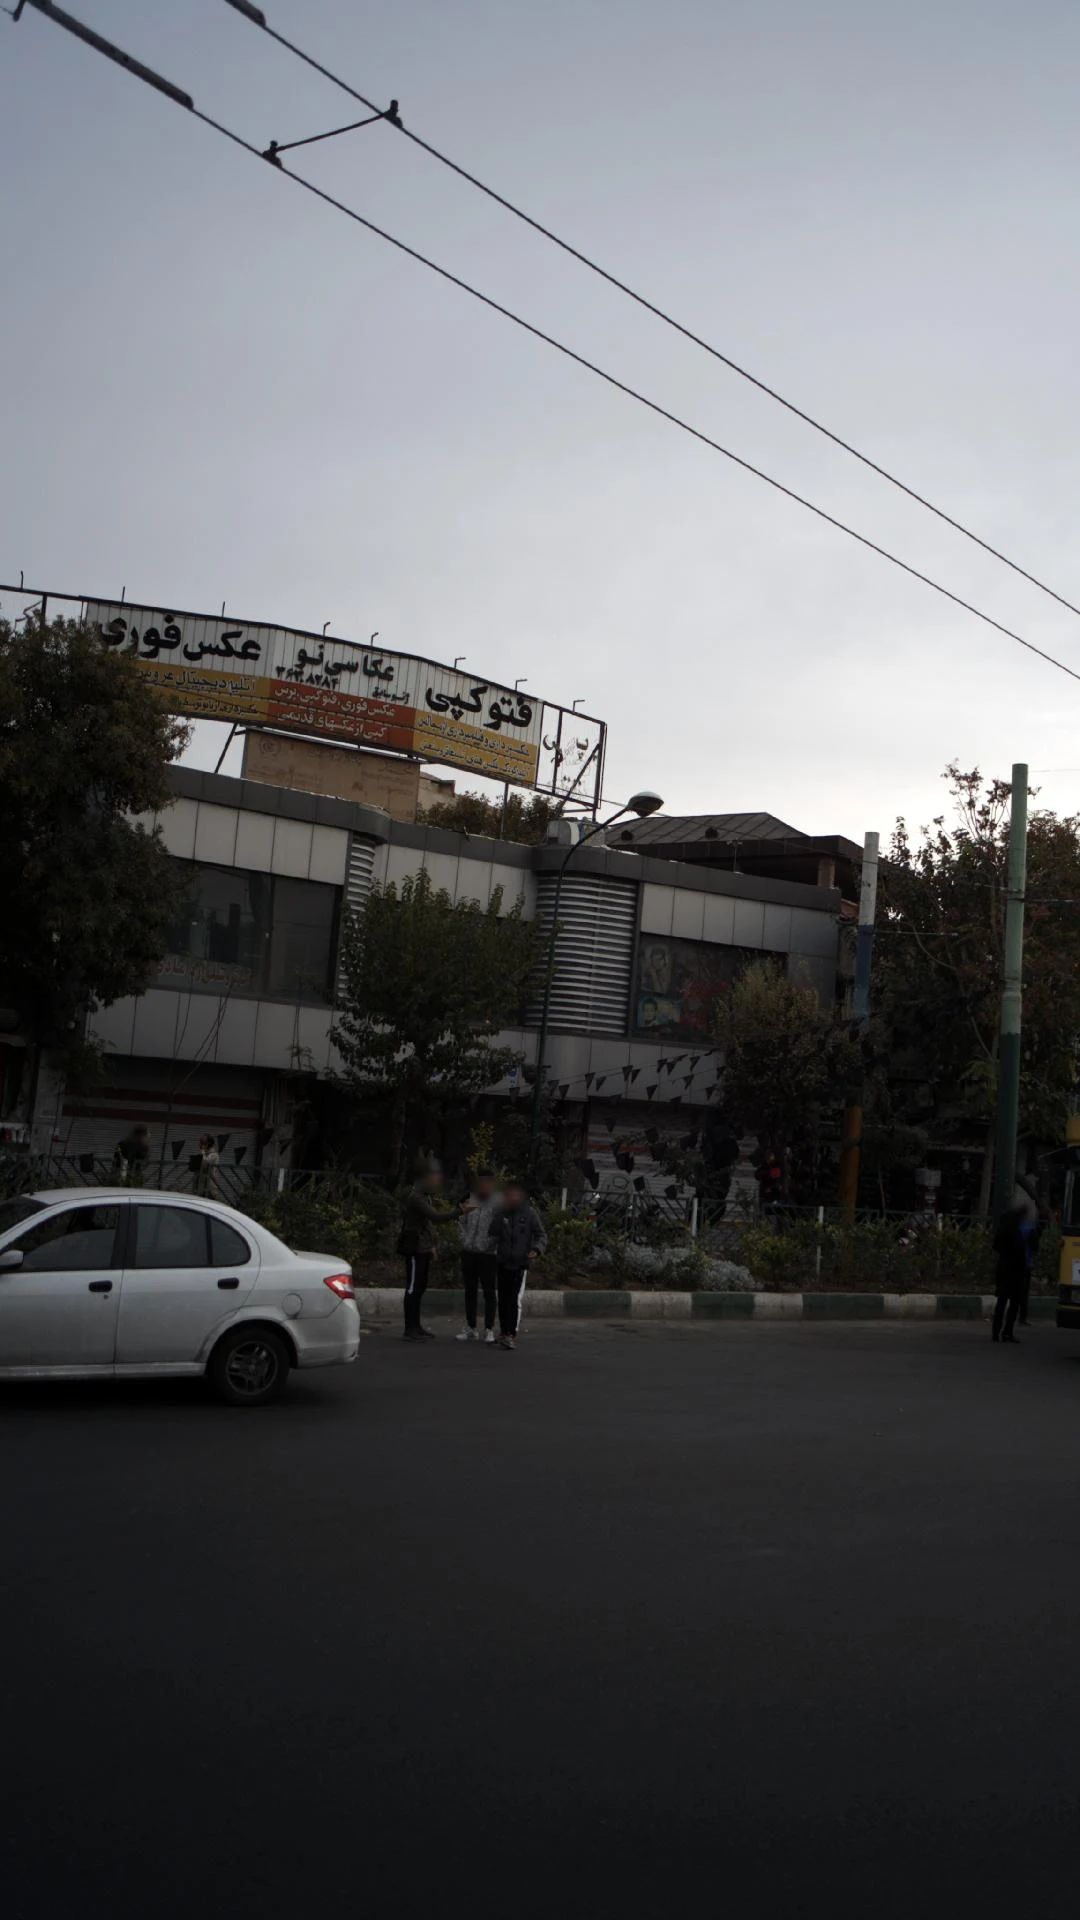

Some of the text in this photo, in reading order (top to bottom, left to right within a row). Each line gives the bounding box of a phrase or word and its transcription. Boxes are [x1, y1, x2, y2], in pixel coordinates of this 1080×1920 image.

[98, 613, 261, 662] عکس فوری
[295, 644, 395, 682] عکاسی نو
[176, 671, 227, 692] دیجیتال
[367, 704, 396, 717] عکس
